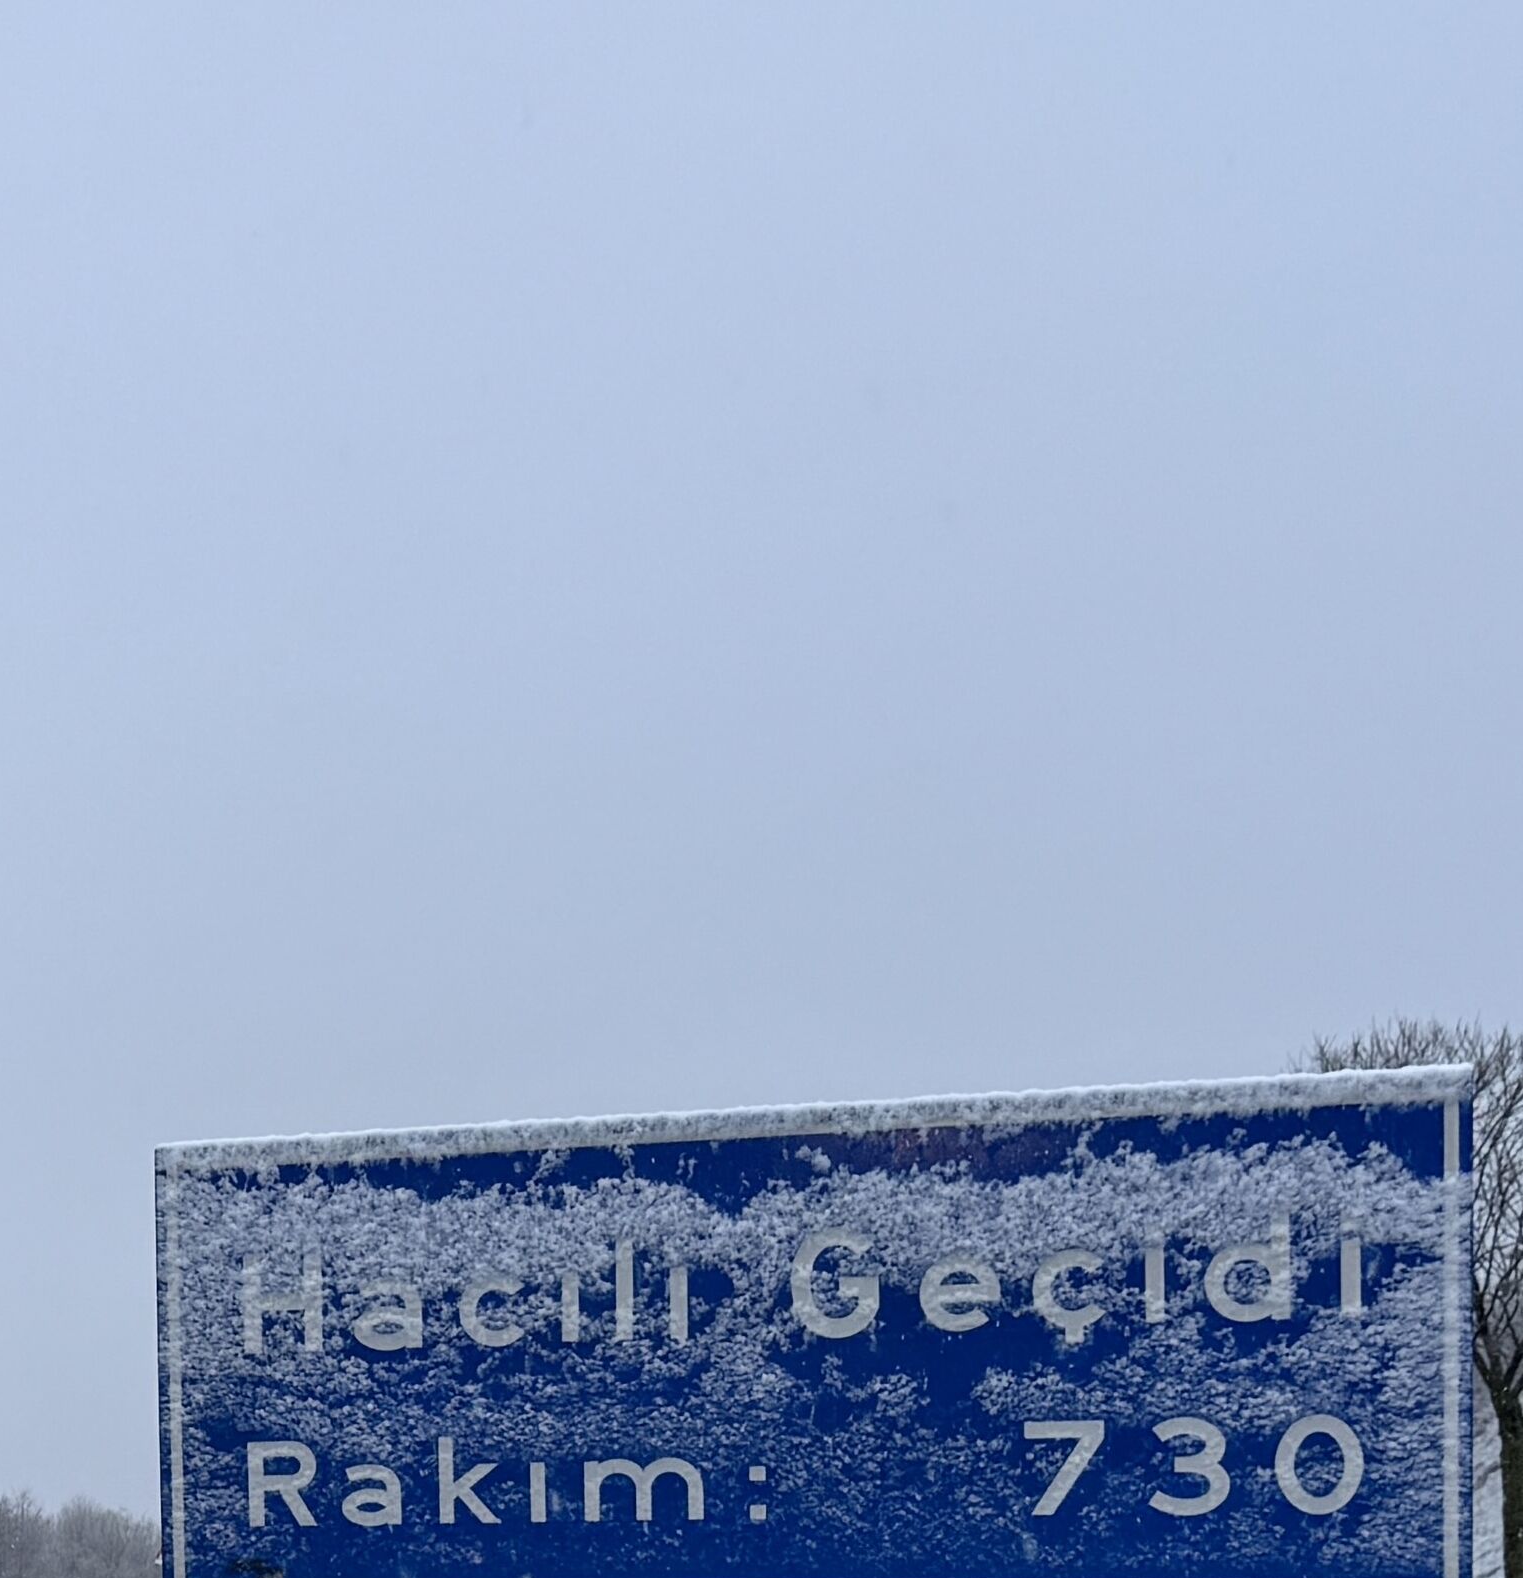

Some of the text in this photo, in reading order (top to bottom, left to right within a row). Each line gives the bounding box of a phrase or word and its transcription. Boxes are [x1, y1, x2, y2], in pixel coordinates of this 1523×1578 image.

[790, 1208, 1362, 1344] Geçidi
[246, 1413, 1366, 1528] Rakım: 730
